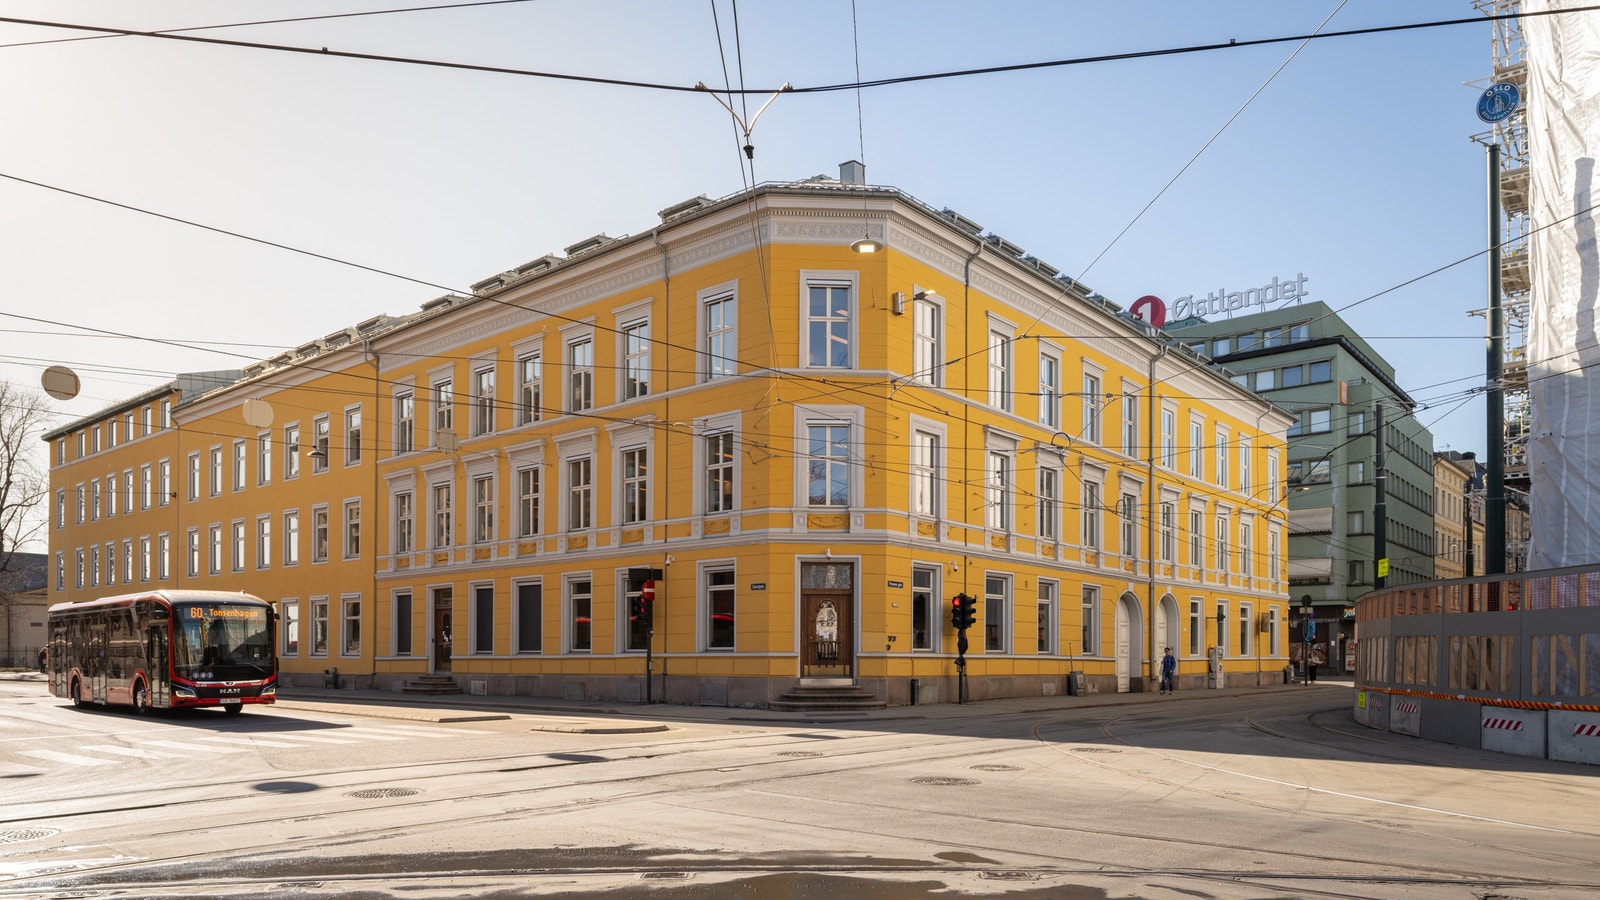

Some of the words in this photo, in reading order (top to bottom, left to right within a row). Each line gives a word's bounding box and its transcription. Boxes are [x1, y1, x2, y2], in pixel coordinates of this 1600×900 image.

[1486, 85, 1511, 97] OSLO
[1171, 272, 1309, 322] Østlandet
[190, 607, 203, 618] 60
[209, 608, 258, 618] Tonsenhagen
